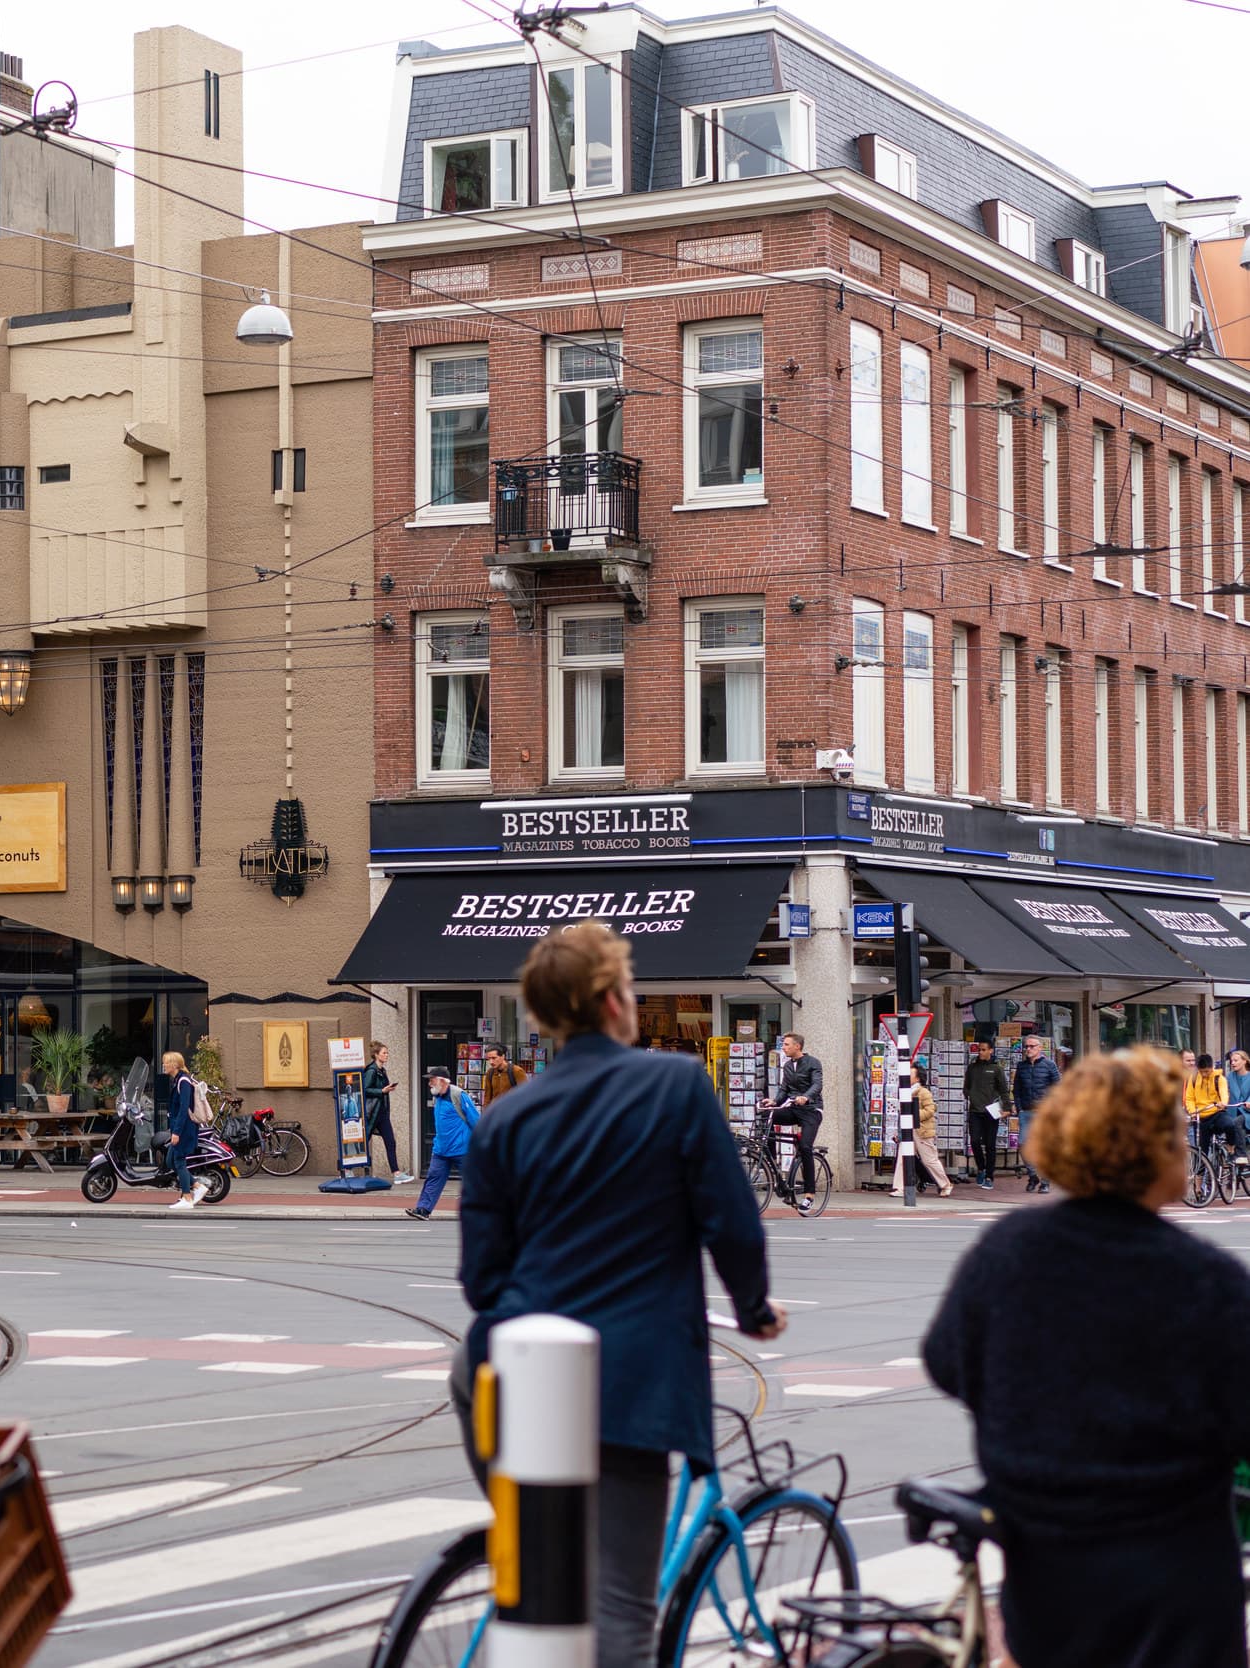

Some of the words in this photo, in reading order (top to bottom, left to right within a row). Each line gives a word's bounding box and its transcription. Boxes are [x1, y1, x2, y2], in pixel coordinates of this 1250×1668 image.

[502, 807, 690, 837] BESTSELLER
[871, 807, 944, 837] BESTSELLER
[503, 840, 575, 852] MAGAZINES
[582, 838, 641, 850] TOBACCO
[649, 836, 690, 848] BOOKS
[452, 889, 695, 919] BESTSELLER
[441, 924, 551, 938] MAGAZINES
[621, 920, 684, 934] BOOKS
